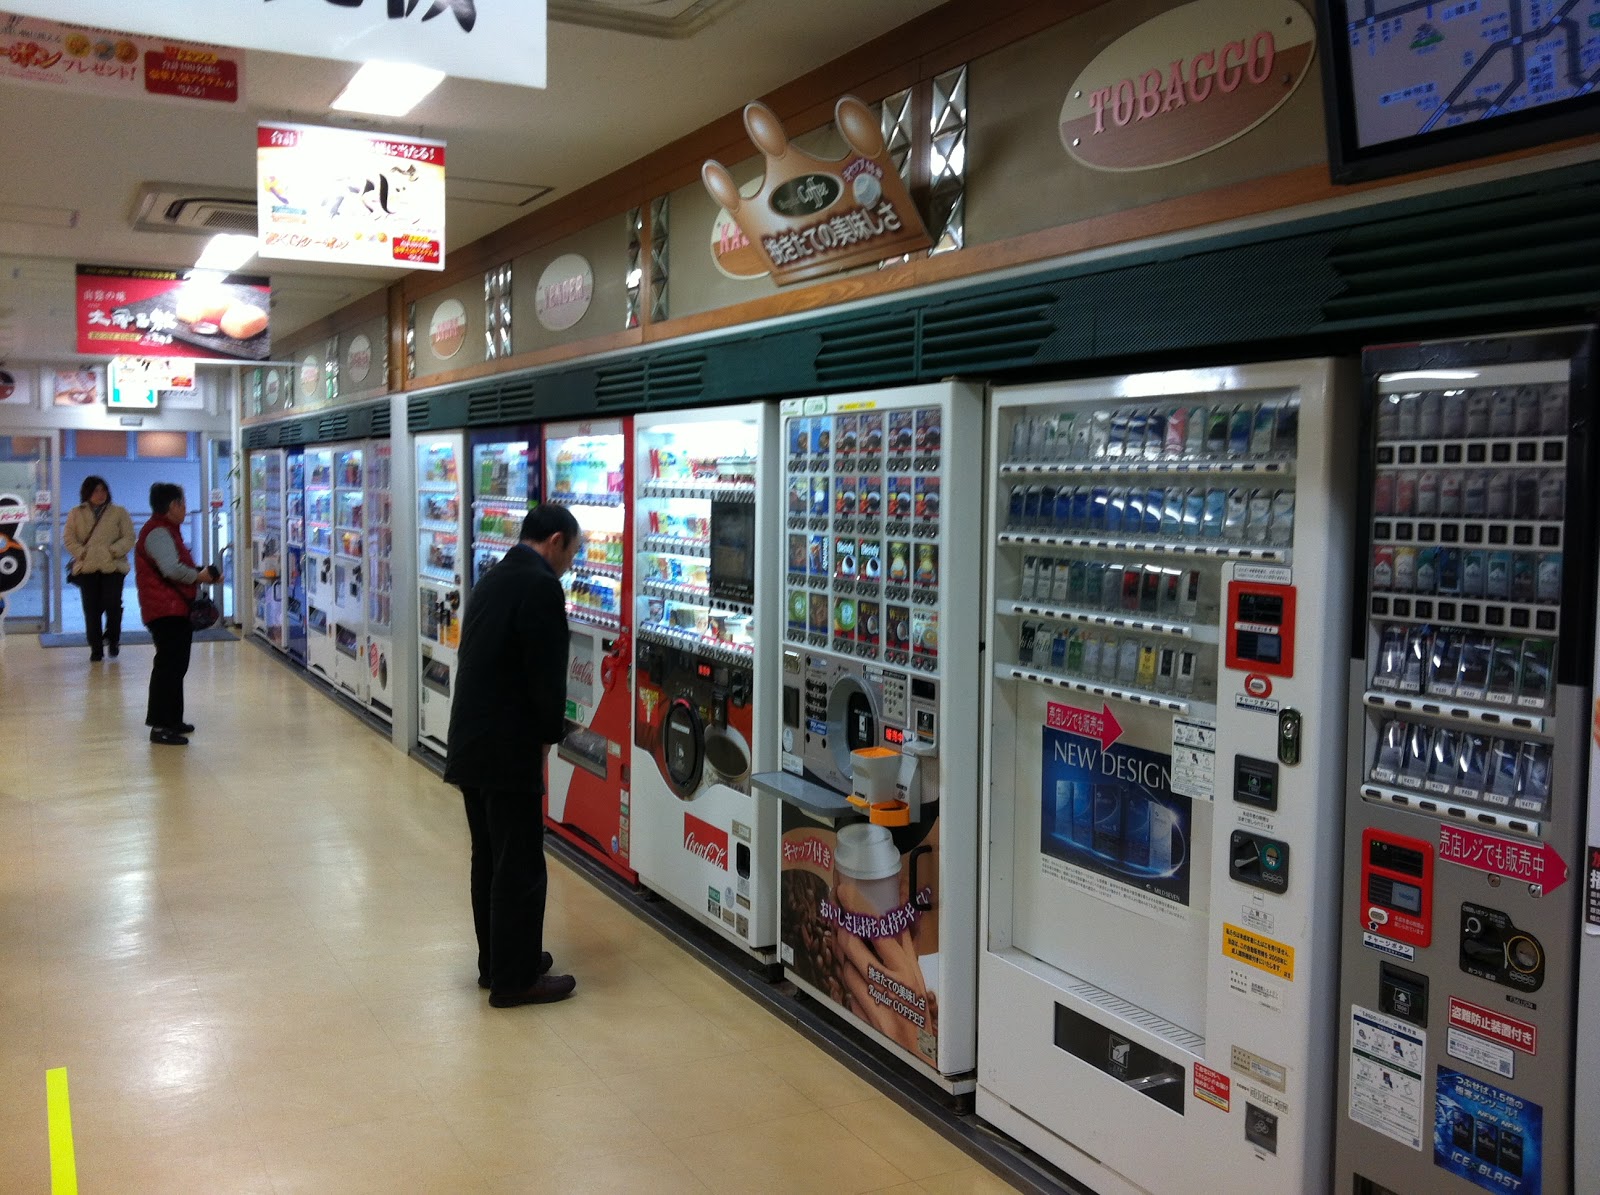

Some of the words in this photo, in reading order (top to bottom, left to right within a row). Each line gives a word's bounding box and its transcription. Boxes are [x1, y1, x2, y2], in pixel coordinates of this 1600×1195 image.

[1088, 30, 1277, 136] TOBACCO
[1048, 704, 1105, 737] 売店レジでも販売中
[1054, 739, 1097, 770] NEW
[1102, 752, 1172, 790] DESIGN
[783, 840, 832, 868] キャップ付き
[1439, 829, 1545, 880] 売店レジでも販売中
[1367, 935, 1411, 954] チャージボタン
[892, 998, 925, 1028] COFFEE
[1451, 1003, 1533, 1047] 盗難防止装置付き
[1477, 1109, 1498, 1122] NEW
[1501, 1120, 1523, 1133] NEW
[1451, 1151, 1471, 1167] ICE
[1478, 1164, 1522, 1190] BLAST
